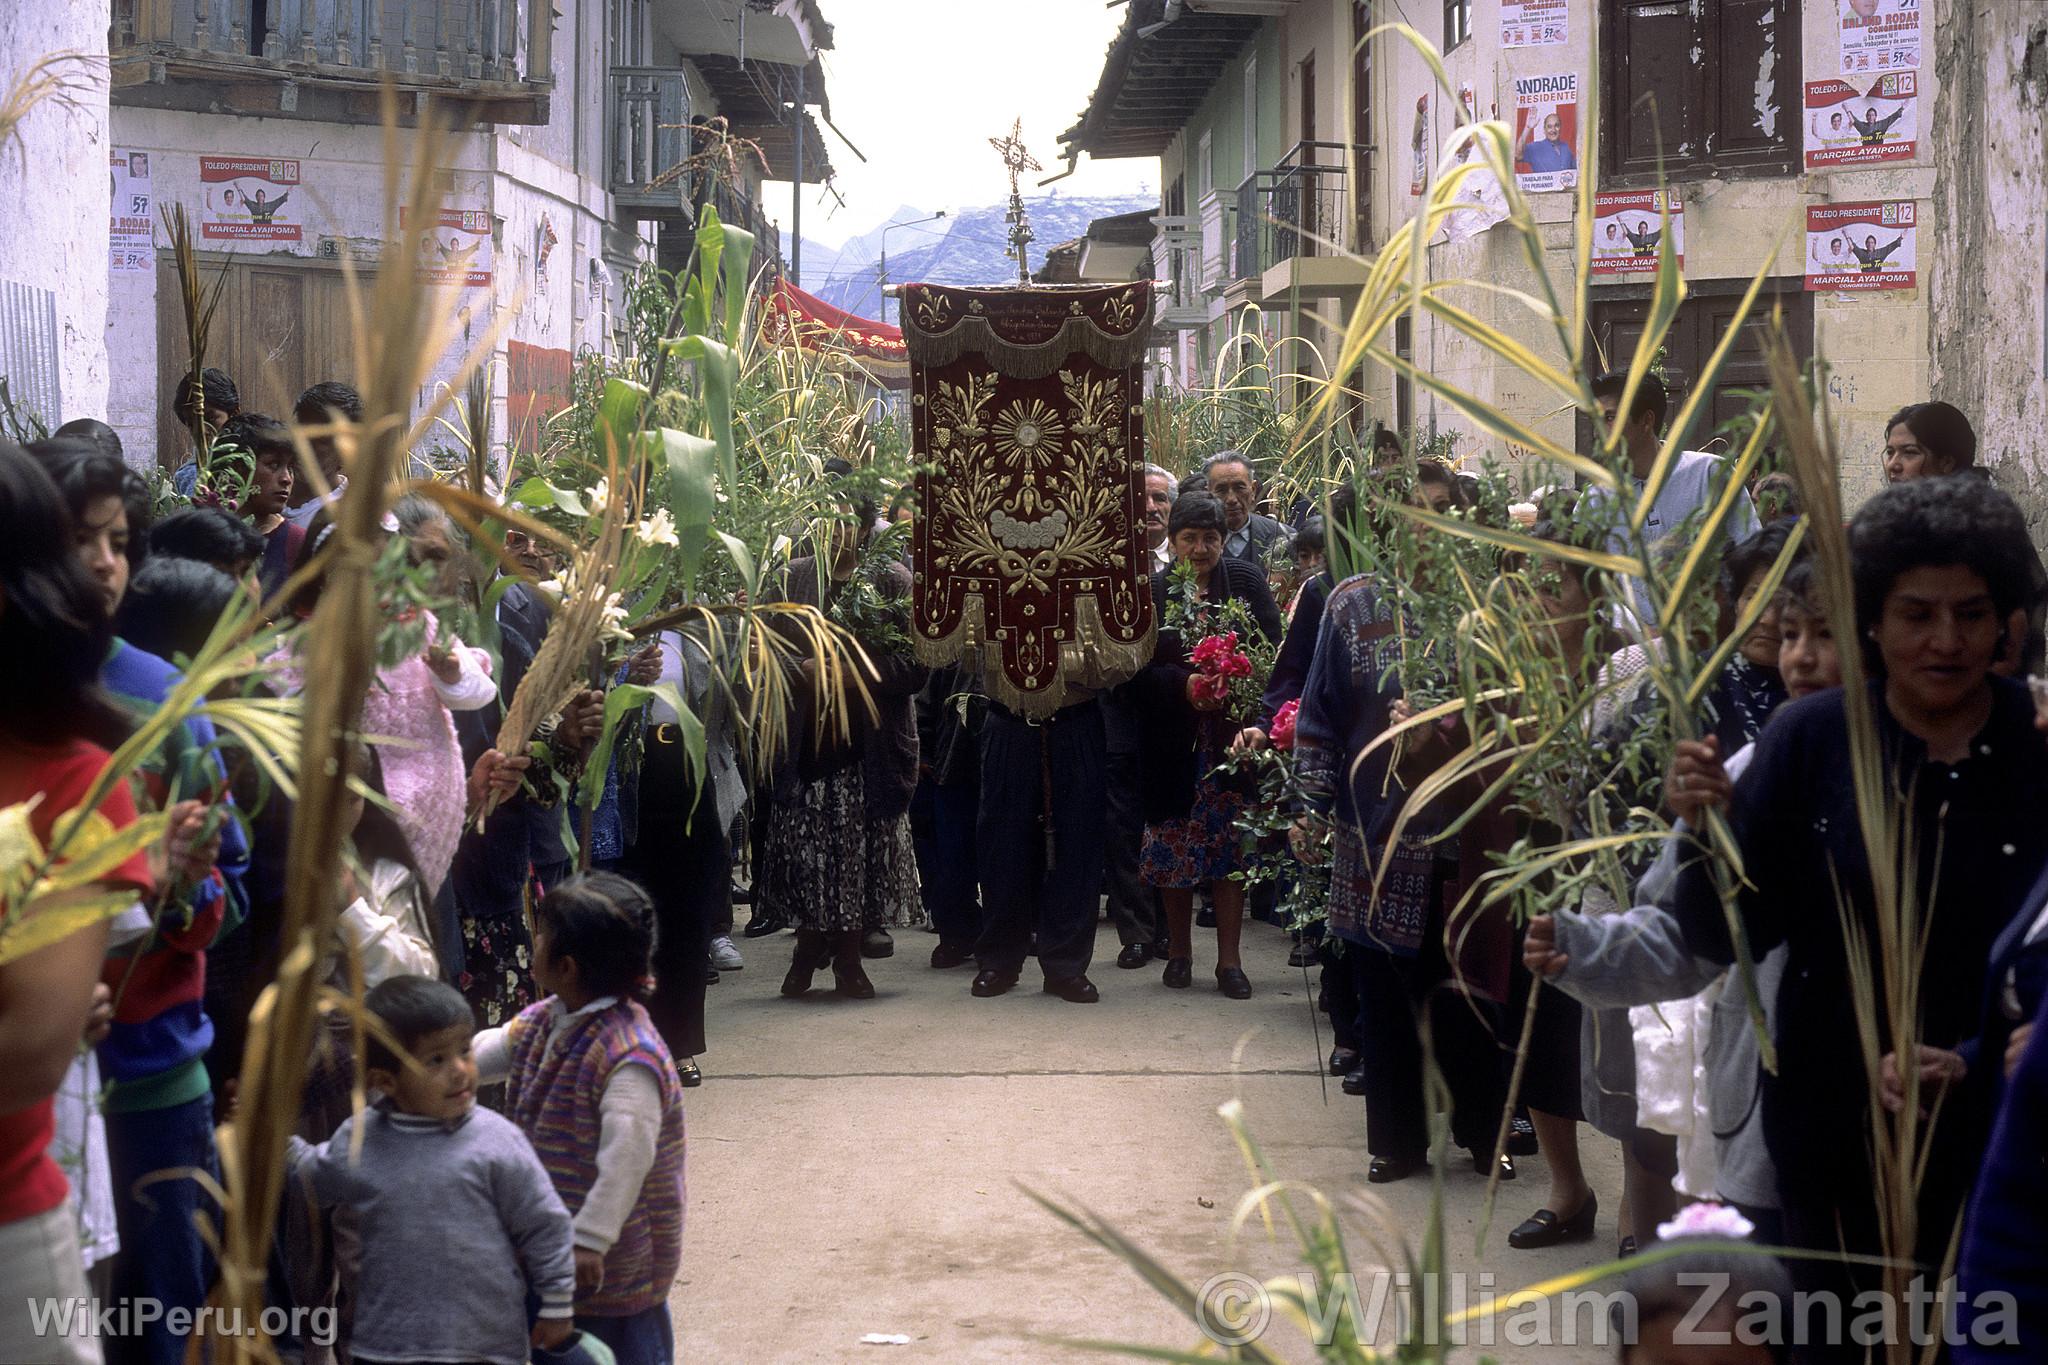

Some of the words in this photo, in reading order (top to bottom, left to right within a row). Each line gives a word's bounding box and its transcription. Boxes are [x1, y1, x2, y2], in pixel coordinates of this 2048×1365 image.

[1885, 11, 1919, 25] RODAS
[1868, 22, 1919, 33] CONGRESISTA
[1893, 51, 1904, 62] 57
[1810, 85, 1838, 95] TOLEDO
[1900, 76, 1912, 92] 12
[1517, 90, 1577, 104] RESIDENTE
[1813, 151, 1856, 160] MARCIAL
[1858, 144, 1911, 156] AYAIPOMA
[204, 161, 230, 170] TOLEDO
[230, 162, 269, 171] PRESIDENTE
[285, 164, 296, 178] 12
[132, 196, 148, 214] 57
[1613, 194, 1653, 204] PRESIDENTE
[1811, 209, 1838, 219] TOLEDO
[1838, 207, 1881, 217] PRESIDENTE
[1899, 206, 1912, 221] 12
[120, 217, 150, 229] RODAS
[476, 214, 486, 228] 12
[209, 225, 249, 233] MARCIAL
[250, 226, 296, 234] AYAIPOMA
[127, 254, 138, 265] 57
[1591, 259, 1630, 268] MARCIAL
[1812, 276, 1856, 285] MARCIAL
[1857, 274, 1910, 283] AYAIPOMA
